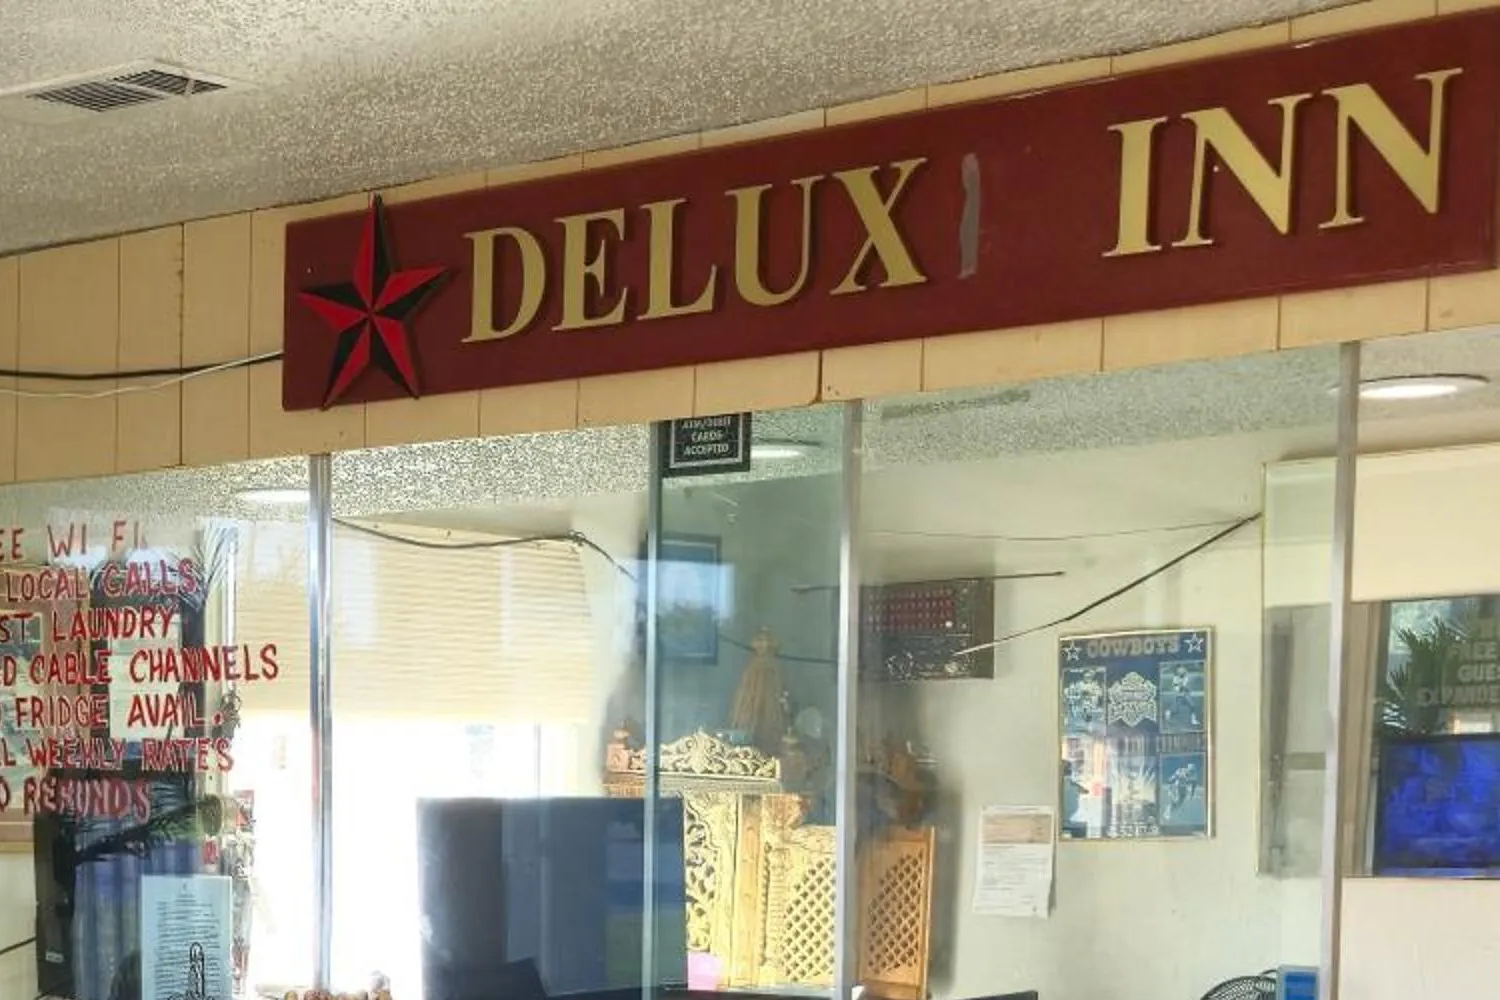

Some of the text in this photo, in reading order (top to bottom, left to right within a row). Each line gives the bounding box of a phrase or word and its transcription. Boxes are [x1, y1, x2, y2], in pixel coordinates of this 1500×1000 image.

[461, 66, 1463, 345] DELUX INN
[6, 567, 89, 602] LOCAL
[104, 558, 200, 598] CALLS
[51, 603, 180, 643] LAUNDRY
[29, 648, 113, 685] CABLE
[129, 643, 280, 683] CHANNELS
[1086, 634, 1181, 659] COWBOYS
[16, 692, 109, 729] FRIDGE
[29, 736, 125, 771] WEEKLY
[141, 736, 235, 773] RATES
[23, 776, 151, 823] REFUNDS
